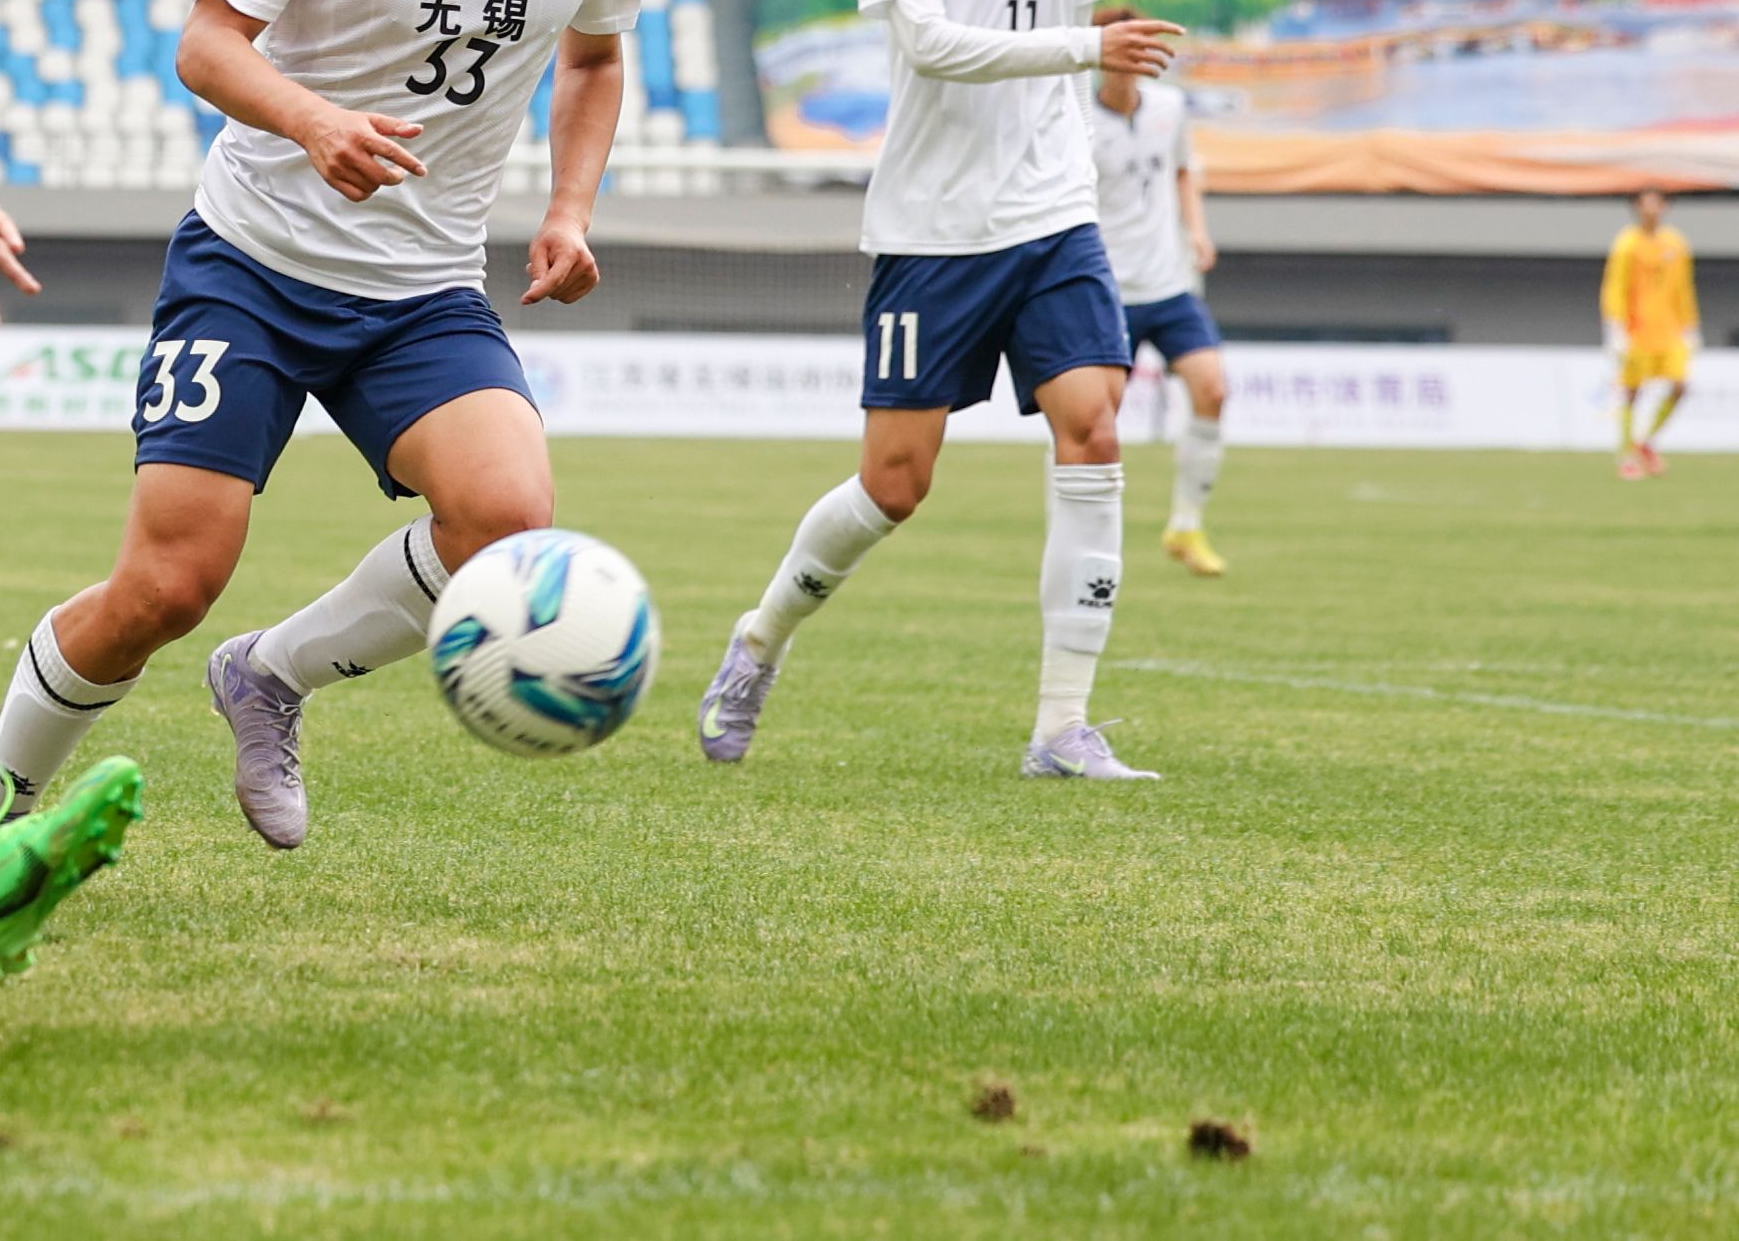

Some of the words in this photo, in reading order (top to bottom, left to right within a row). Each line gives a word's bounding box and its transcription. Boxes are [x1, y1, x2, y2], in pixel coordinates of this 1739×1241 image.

[1007, 0, 1037, 32] 11
[405, 37, 500, 105] 33
[878, 312, 918, 379] 11
[143, 339, 229, 423] 33
